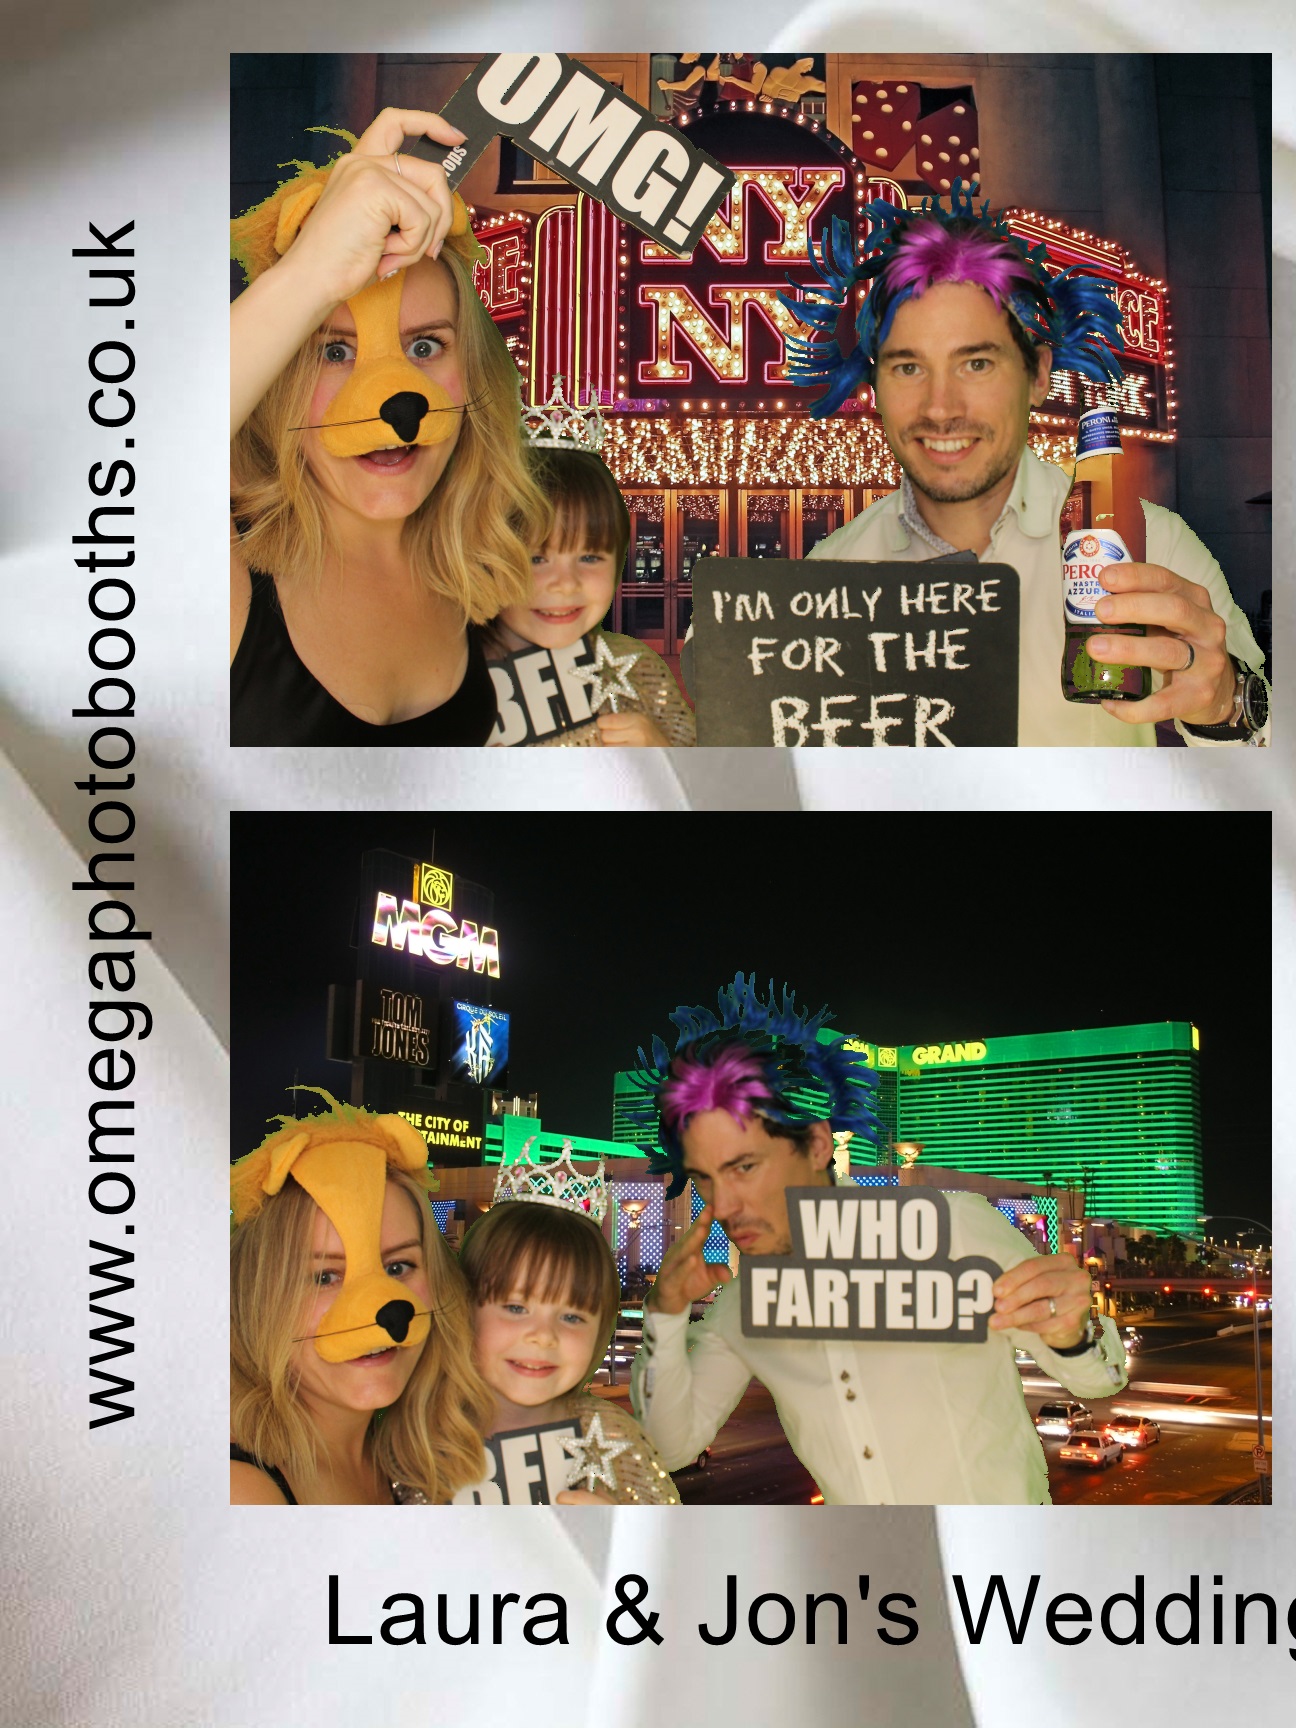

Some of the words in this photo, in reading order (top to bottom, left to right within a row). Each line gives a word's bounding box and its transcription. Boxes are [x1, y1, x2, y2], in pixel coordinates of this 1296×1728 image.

[476, 53, 726, 247] OMG!
[638, 285, 847, 383] NY
[1081, 416, 1111, 430] PERONI
[1063, 564, 1105, 580] PERO
[712, 590, 774, 623] I'M
[790, 586, 882, 621] ONLY
[900, 579, 1002, 616] HERE
[747, 635, 846, 677] FOR
[867, 628, 970, 672] THE
[372, 891, 500, 979] MGM
[380, 989, 422, 1028] TOM
[456, 1002, 478, 1015] CIRQUE
[372, 1022, 430, 1066] JONES
[912, 1042, 987, 1065] GRAND
[418, 1130, 482, 1149] TAINMENT
[424, 1115, 451, 1130] CITY
[453, 1119, 469, 1133] OF
[799, 1198, 938, 1261] WHO
[751, 1268, 994, 1331] FARTED?
